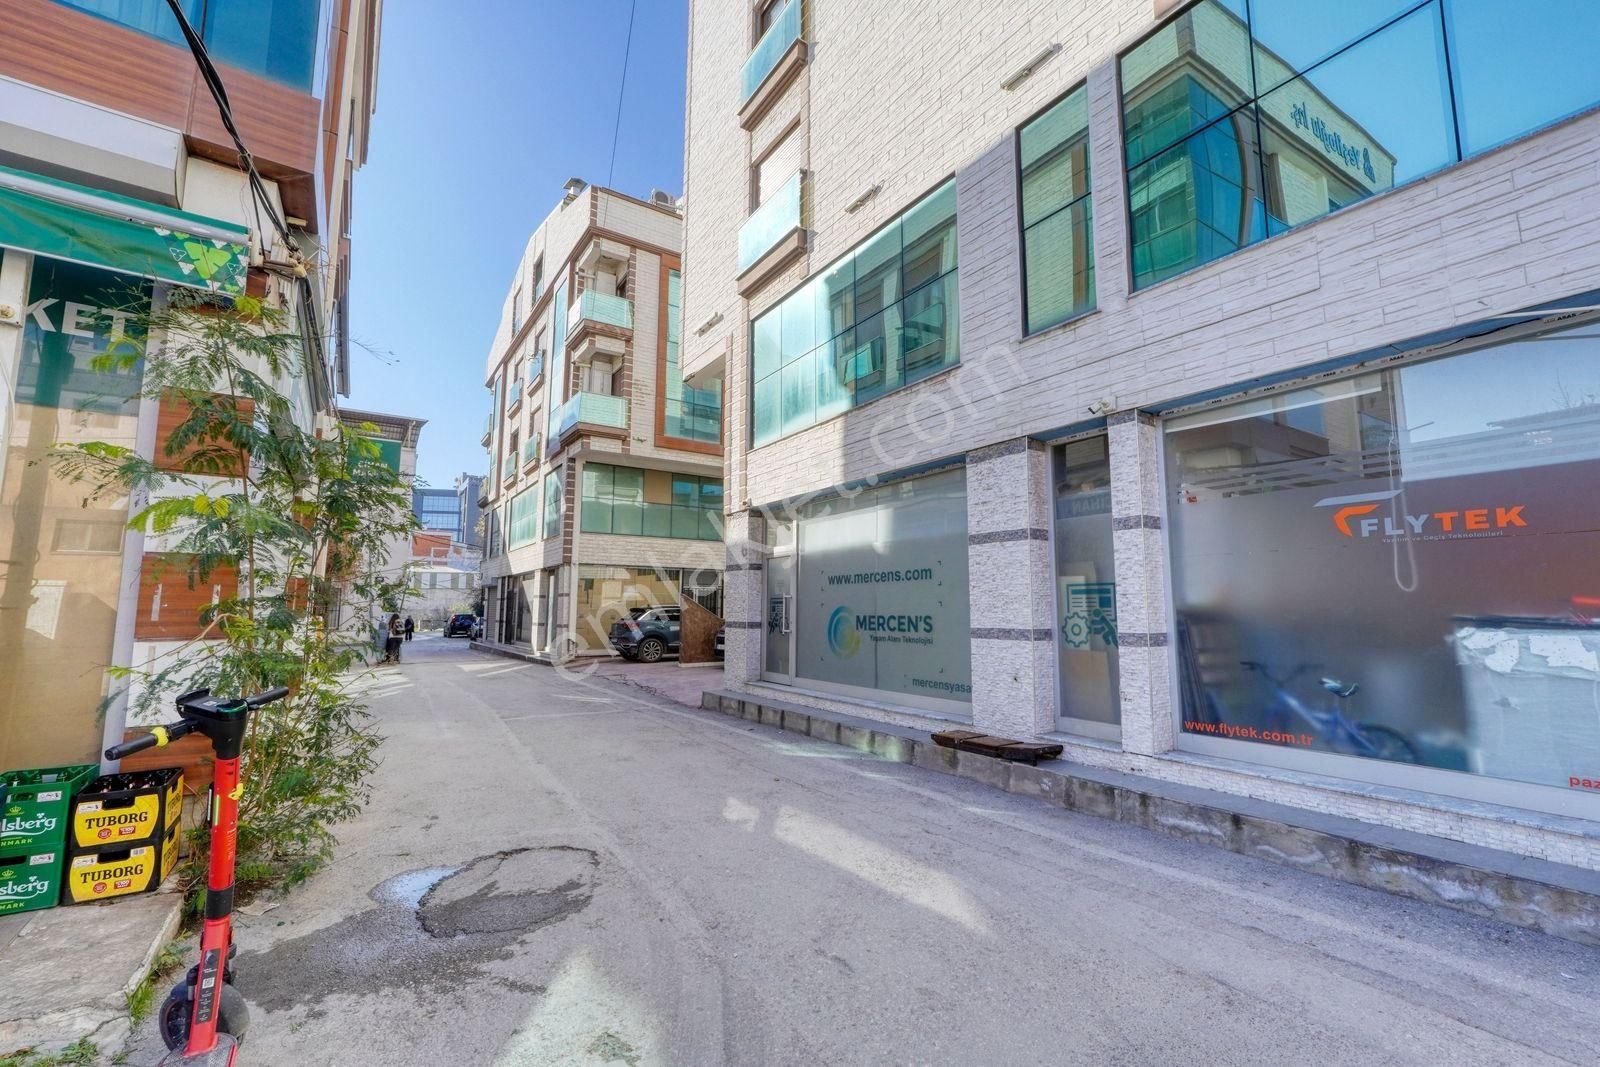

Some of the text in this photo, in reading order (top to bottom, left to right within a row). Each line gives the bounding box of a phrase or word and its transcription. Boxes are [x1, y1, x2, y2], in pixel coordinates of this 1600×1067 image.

[1360, 504, 1528, 538] FLYTEK
[827, 567, 932, 586] www.mercens.com
[855, 614, 934, 634] MERCEN'S
[1184, 720, 1313, 746] www.flytek.com.tr
[85, 811, 148, 830] TUBORG
[80, 864, 144, 884] TUBORG
